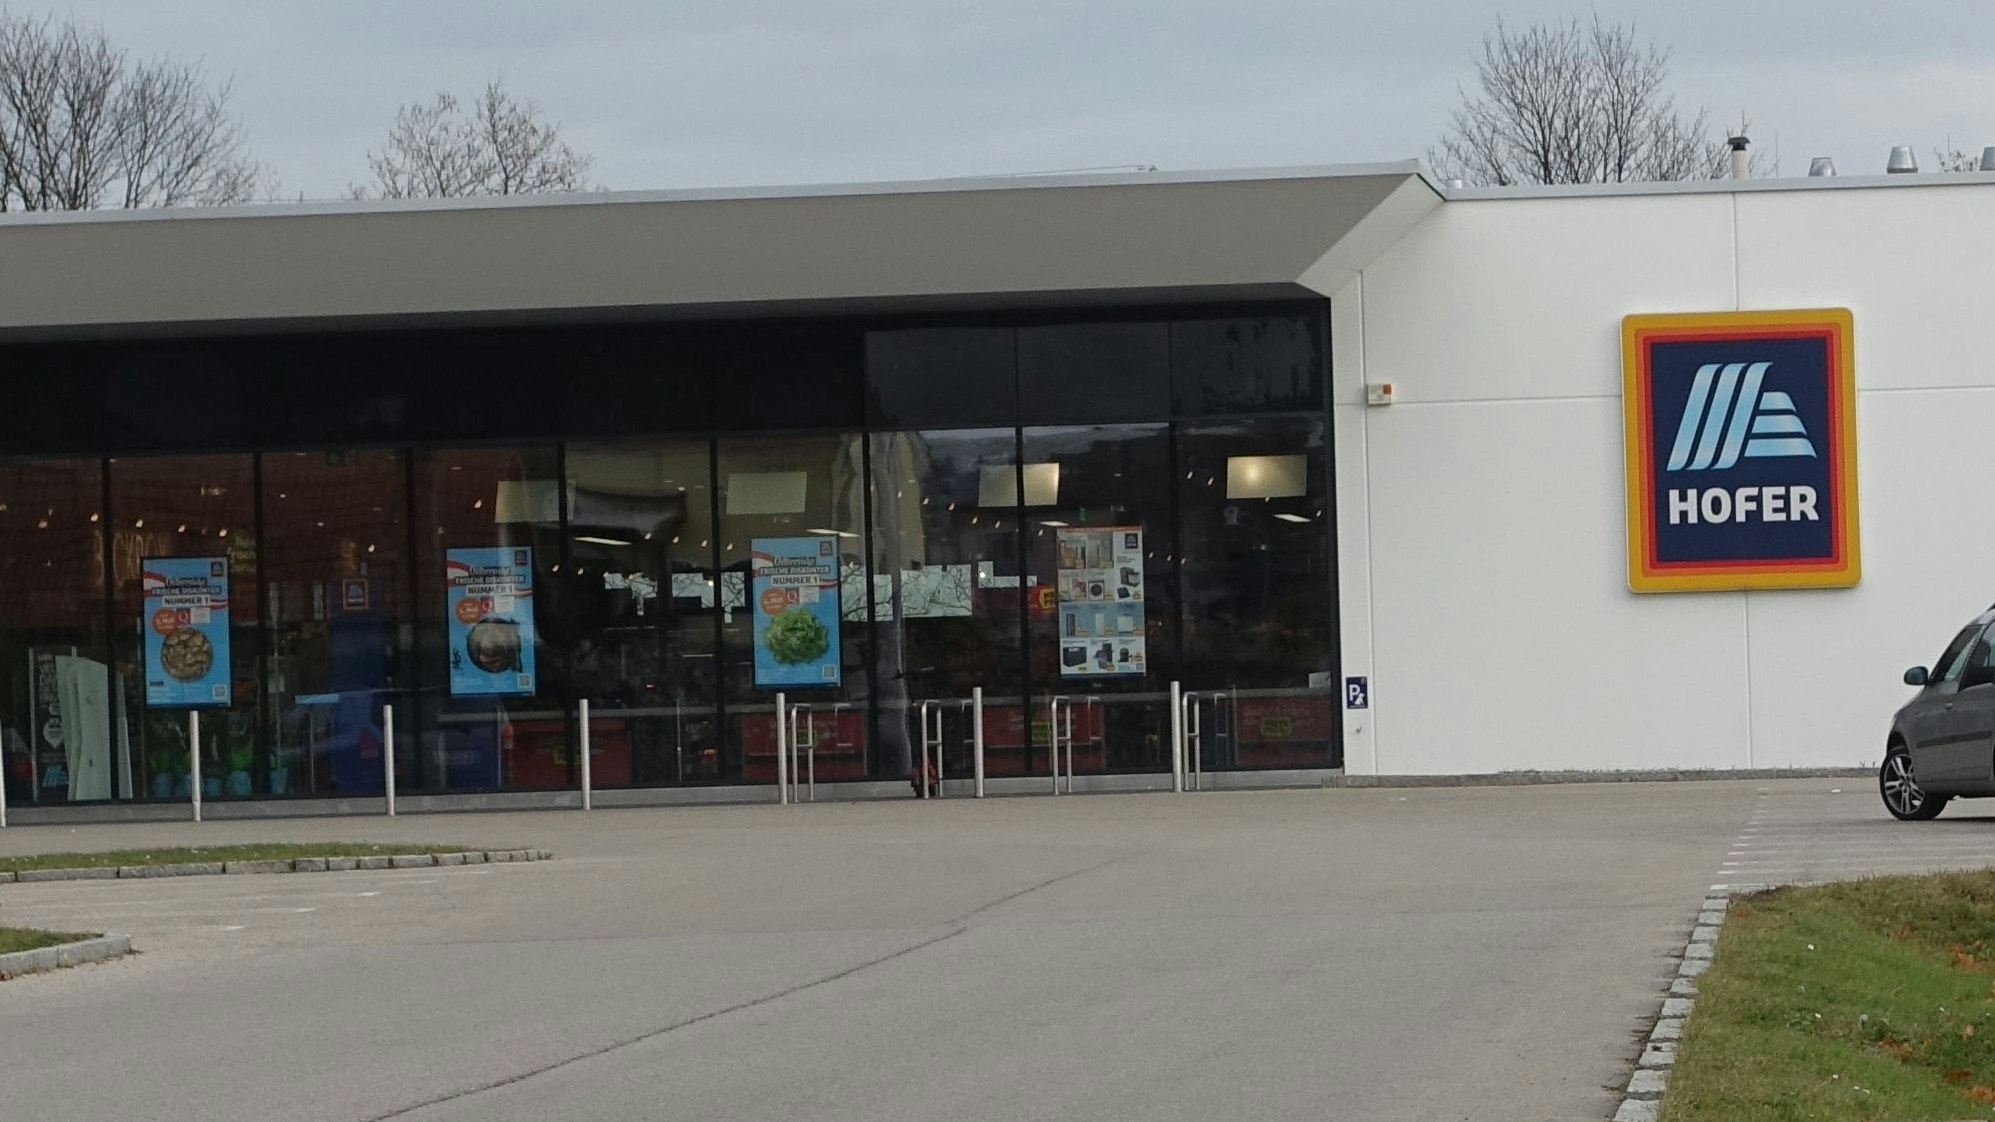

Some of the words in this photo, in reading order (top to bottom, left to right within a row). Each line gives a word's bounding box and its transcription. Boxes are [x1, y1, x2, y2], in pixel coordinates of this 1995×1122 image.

[1669, 485, 1819, 524] HOFER
[772, 576, 811, 584] NUMMER
[467, 585, 506, 594] NUMMER
[164, 596, 202, 604] NUMMER
[1349, 684, 1361, 701] P
